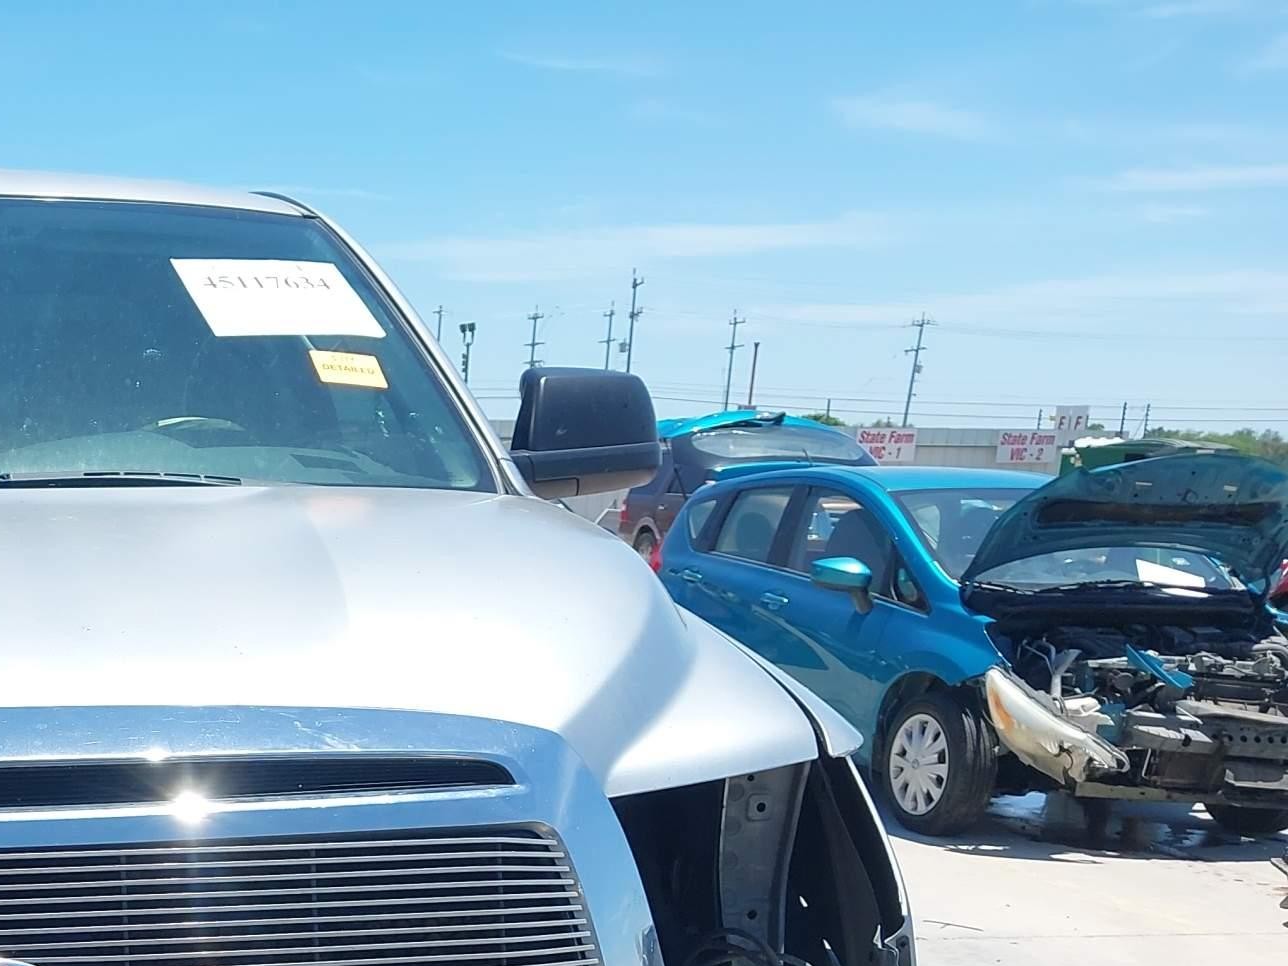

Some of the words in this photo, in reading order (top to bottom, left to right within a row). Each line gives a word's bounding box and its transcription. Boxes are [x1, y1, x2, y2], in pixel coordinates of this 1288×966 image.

[202, 276, 330, 290] 45117634
[858, 430, 886, 444] State
[888, 431, 914, 444] Farm
[1000, 432, 1028, 445] State
[1030, 432, 1056, 445] Farm
[1009, 448, 1028, 461] VIC
[1035, 448, 1044, 461] 2
